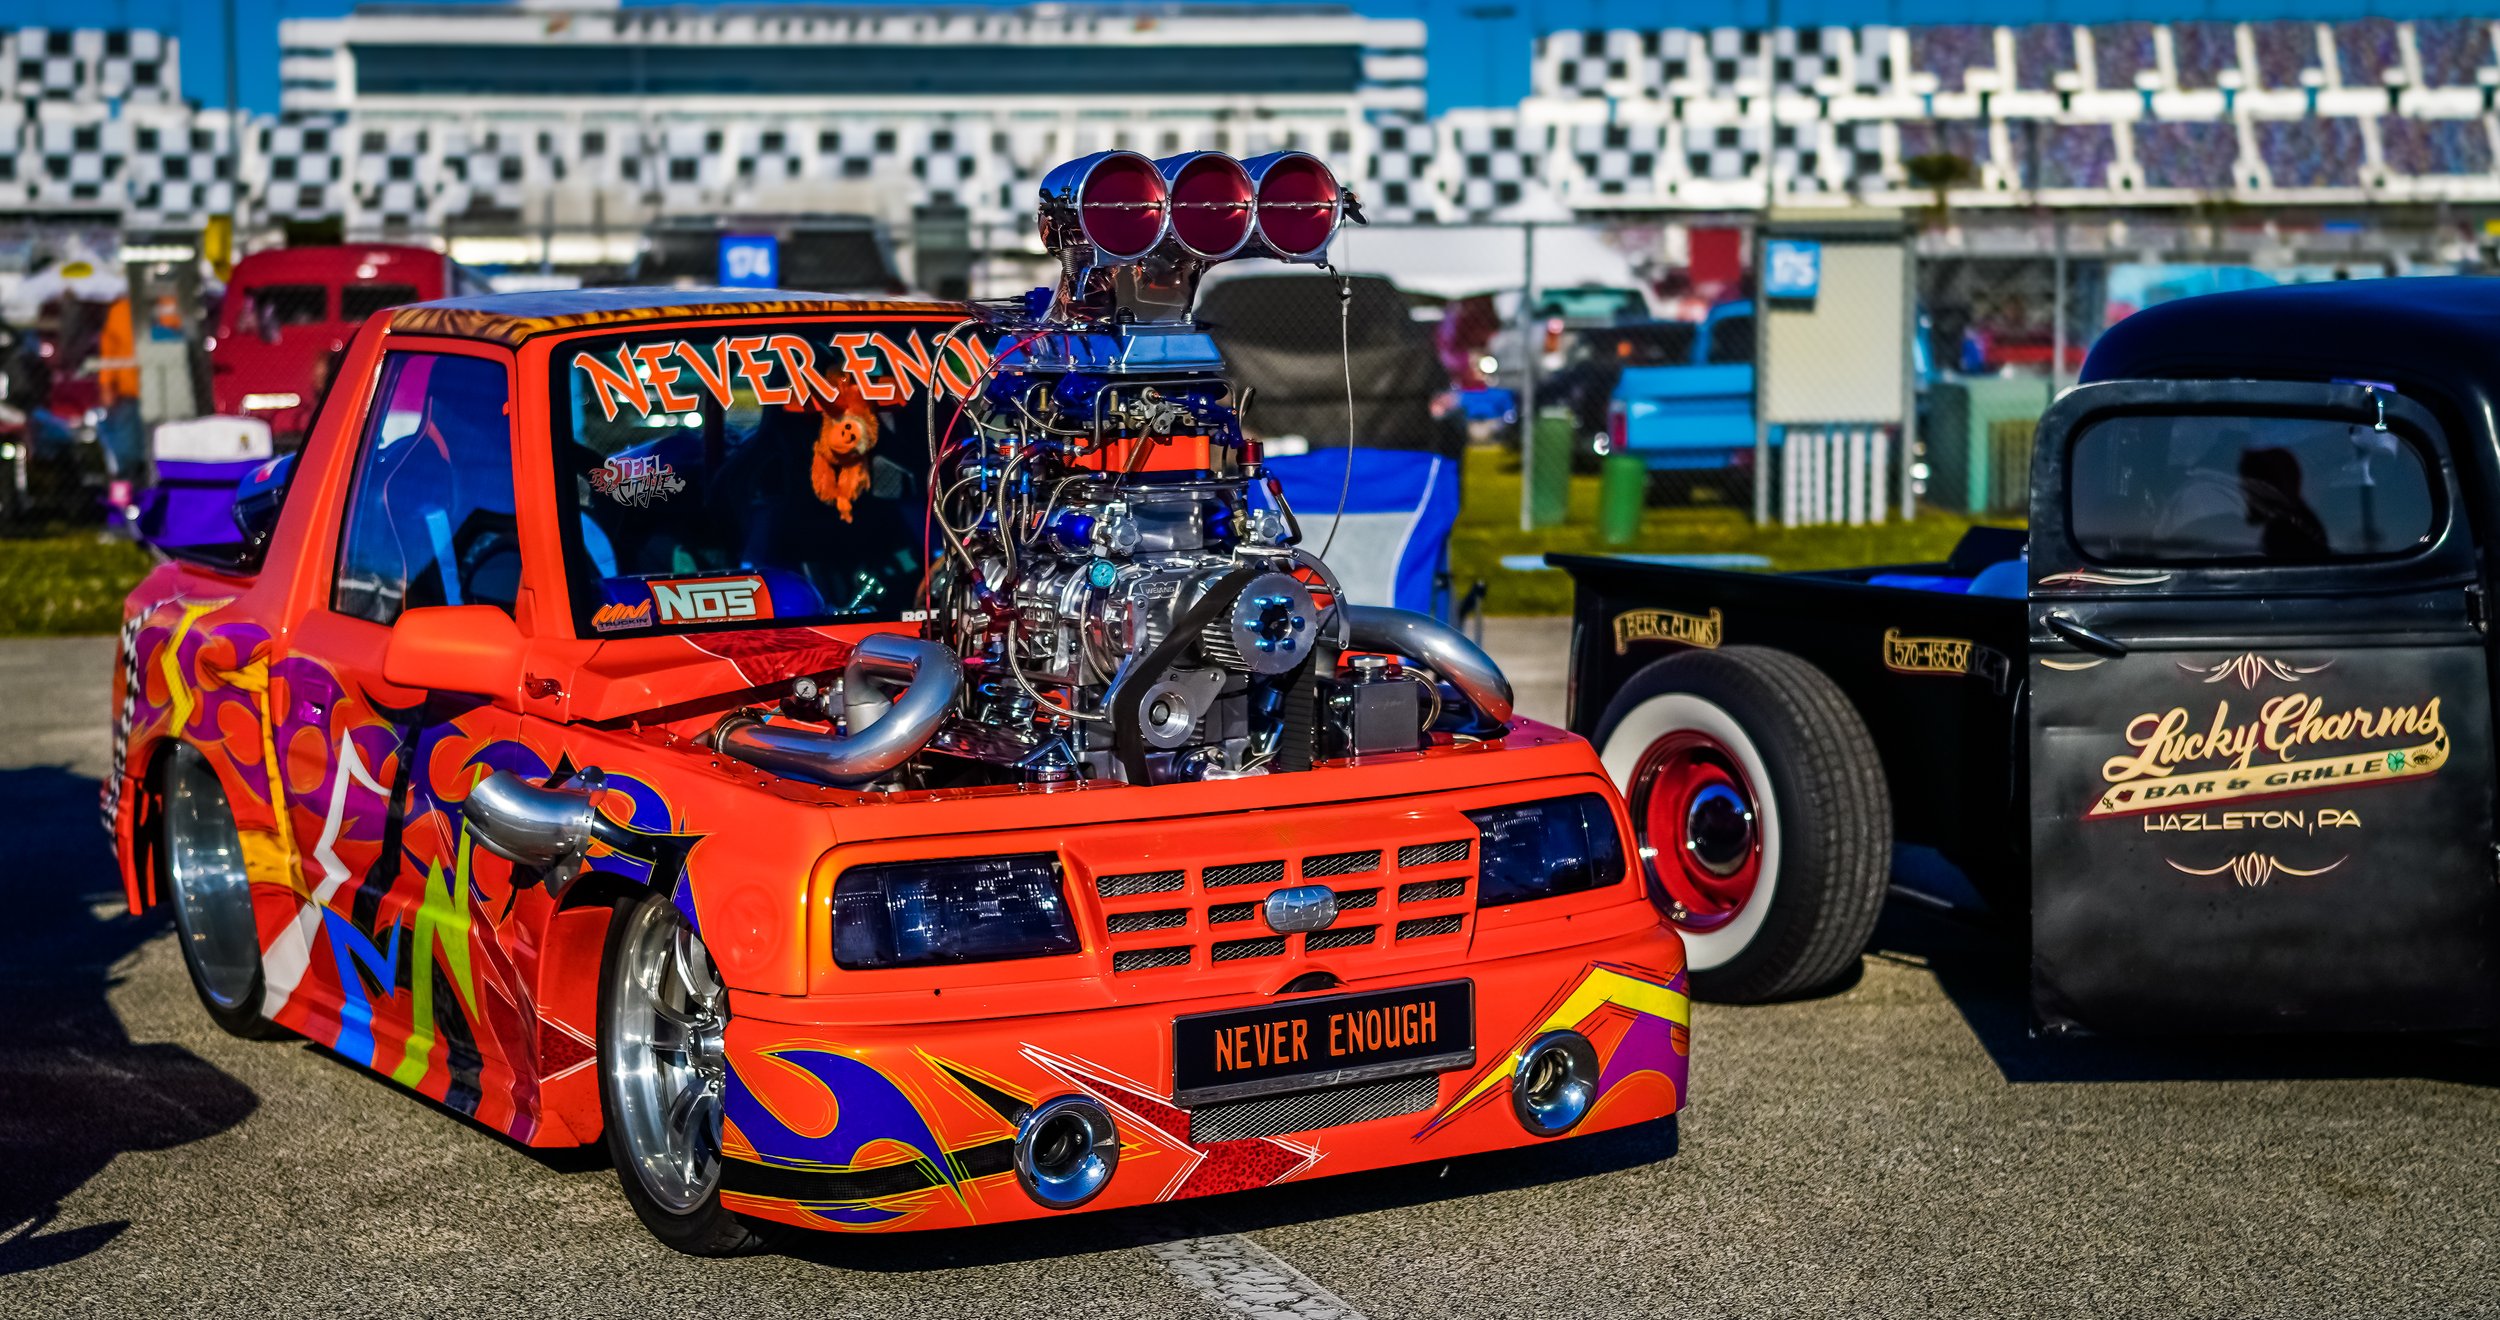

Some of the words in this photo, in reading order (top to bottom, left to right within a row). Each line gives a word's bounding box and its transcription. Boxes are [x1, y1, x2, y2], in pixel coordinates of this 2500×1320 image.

[573, 333, 839, 422] NEVER
[603, 454, 670, 483] STEEL
[617, 473, 676, 509] STYLE
[591, 598, 652, 626] MINI
[653, 578, 762, 621] NOS
[1626, 614, 1660, 637] BEER
[1671, 615, 1714, 645] CLAMS
[2102, 700, 2260, 783] Lucky
[2260, 692, 2446, 762] Charms
[2144, 779, 2215, 800] BAR
[2226, 778, 2251, 791] &
[2265, 758, 2383, 786] GRILLE
[2317, 808, 2361, 828] PA
[1215, 1019, 1309, 1072] NEVER
[1329, 1001, 1437, 1057] ENOUGH
